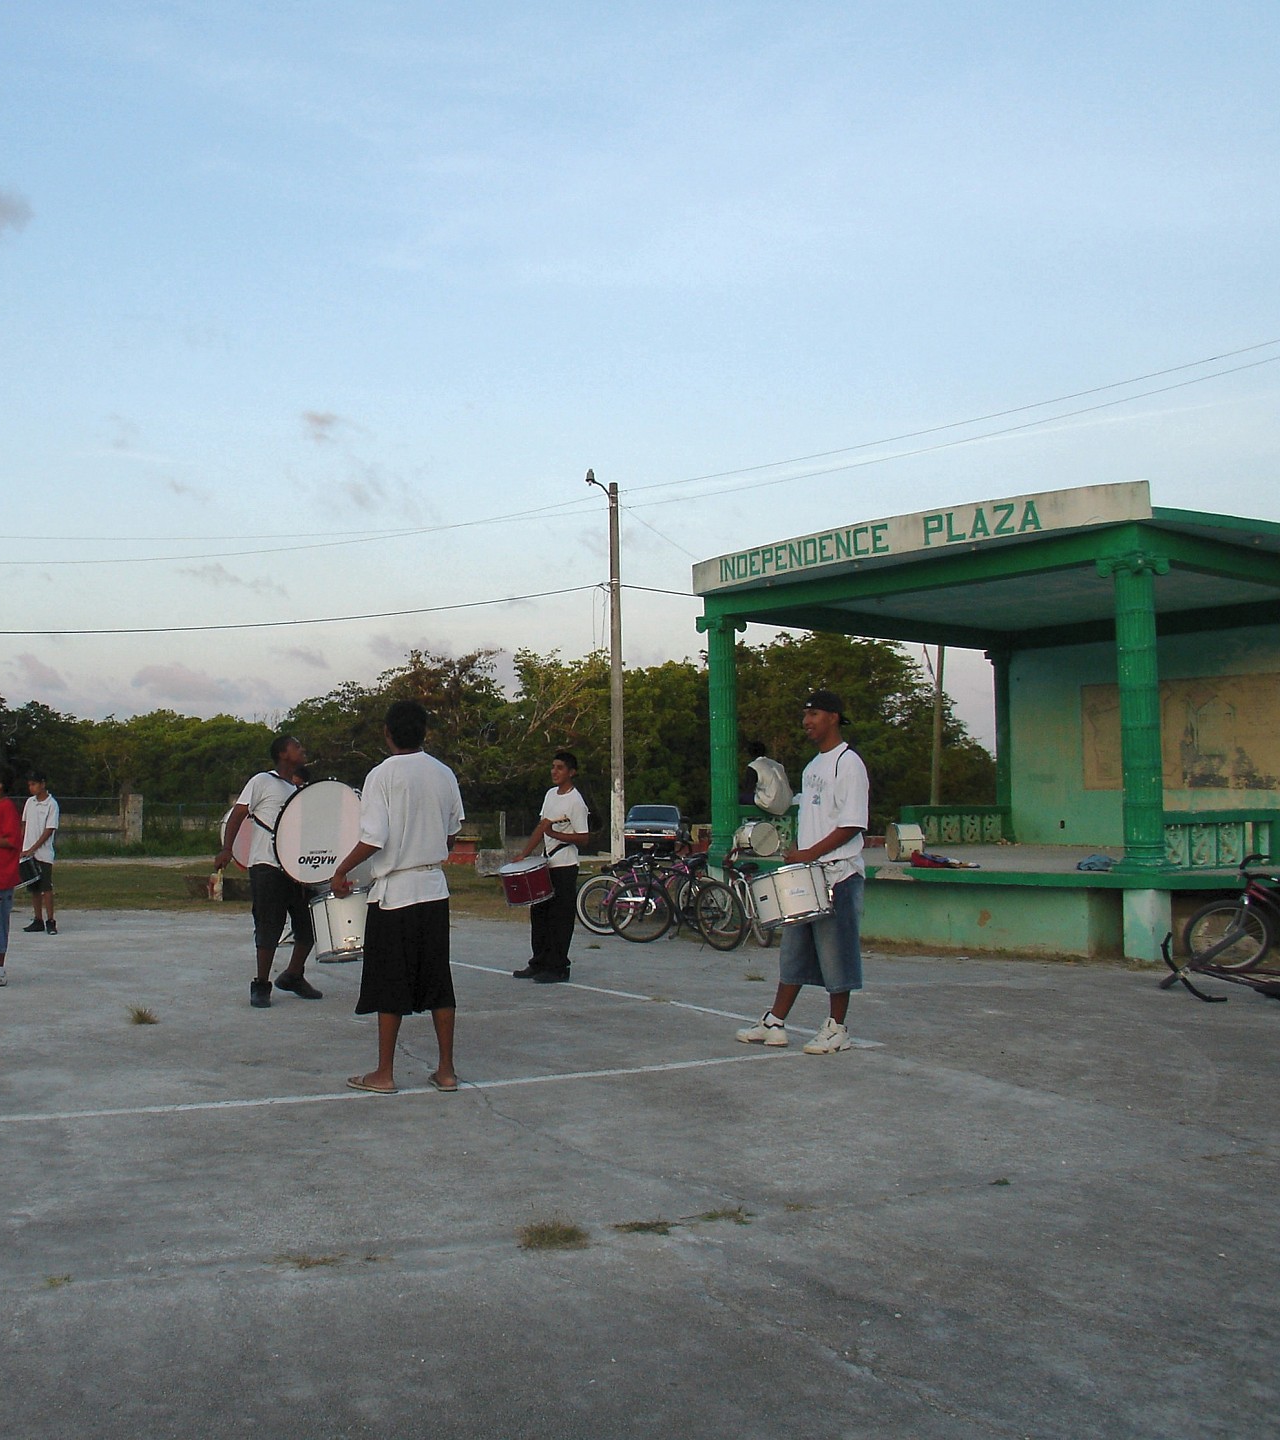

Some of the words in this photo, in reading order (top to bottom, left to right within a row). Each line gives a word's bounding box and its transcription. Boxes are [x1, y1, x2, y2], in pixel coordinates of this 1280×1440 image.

[719, 523, 889, 583] INDEPENDENCE
[923, 500, 1042, 546] PLAZA
[298, 856, 337, 865] MAGNO
